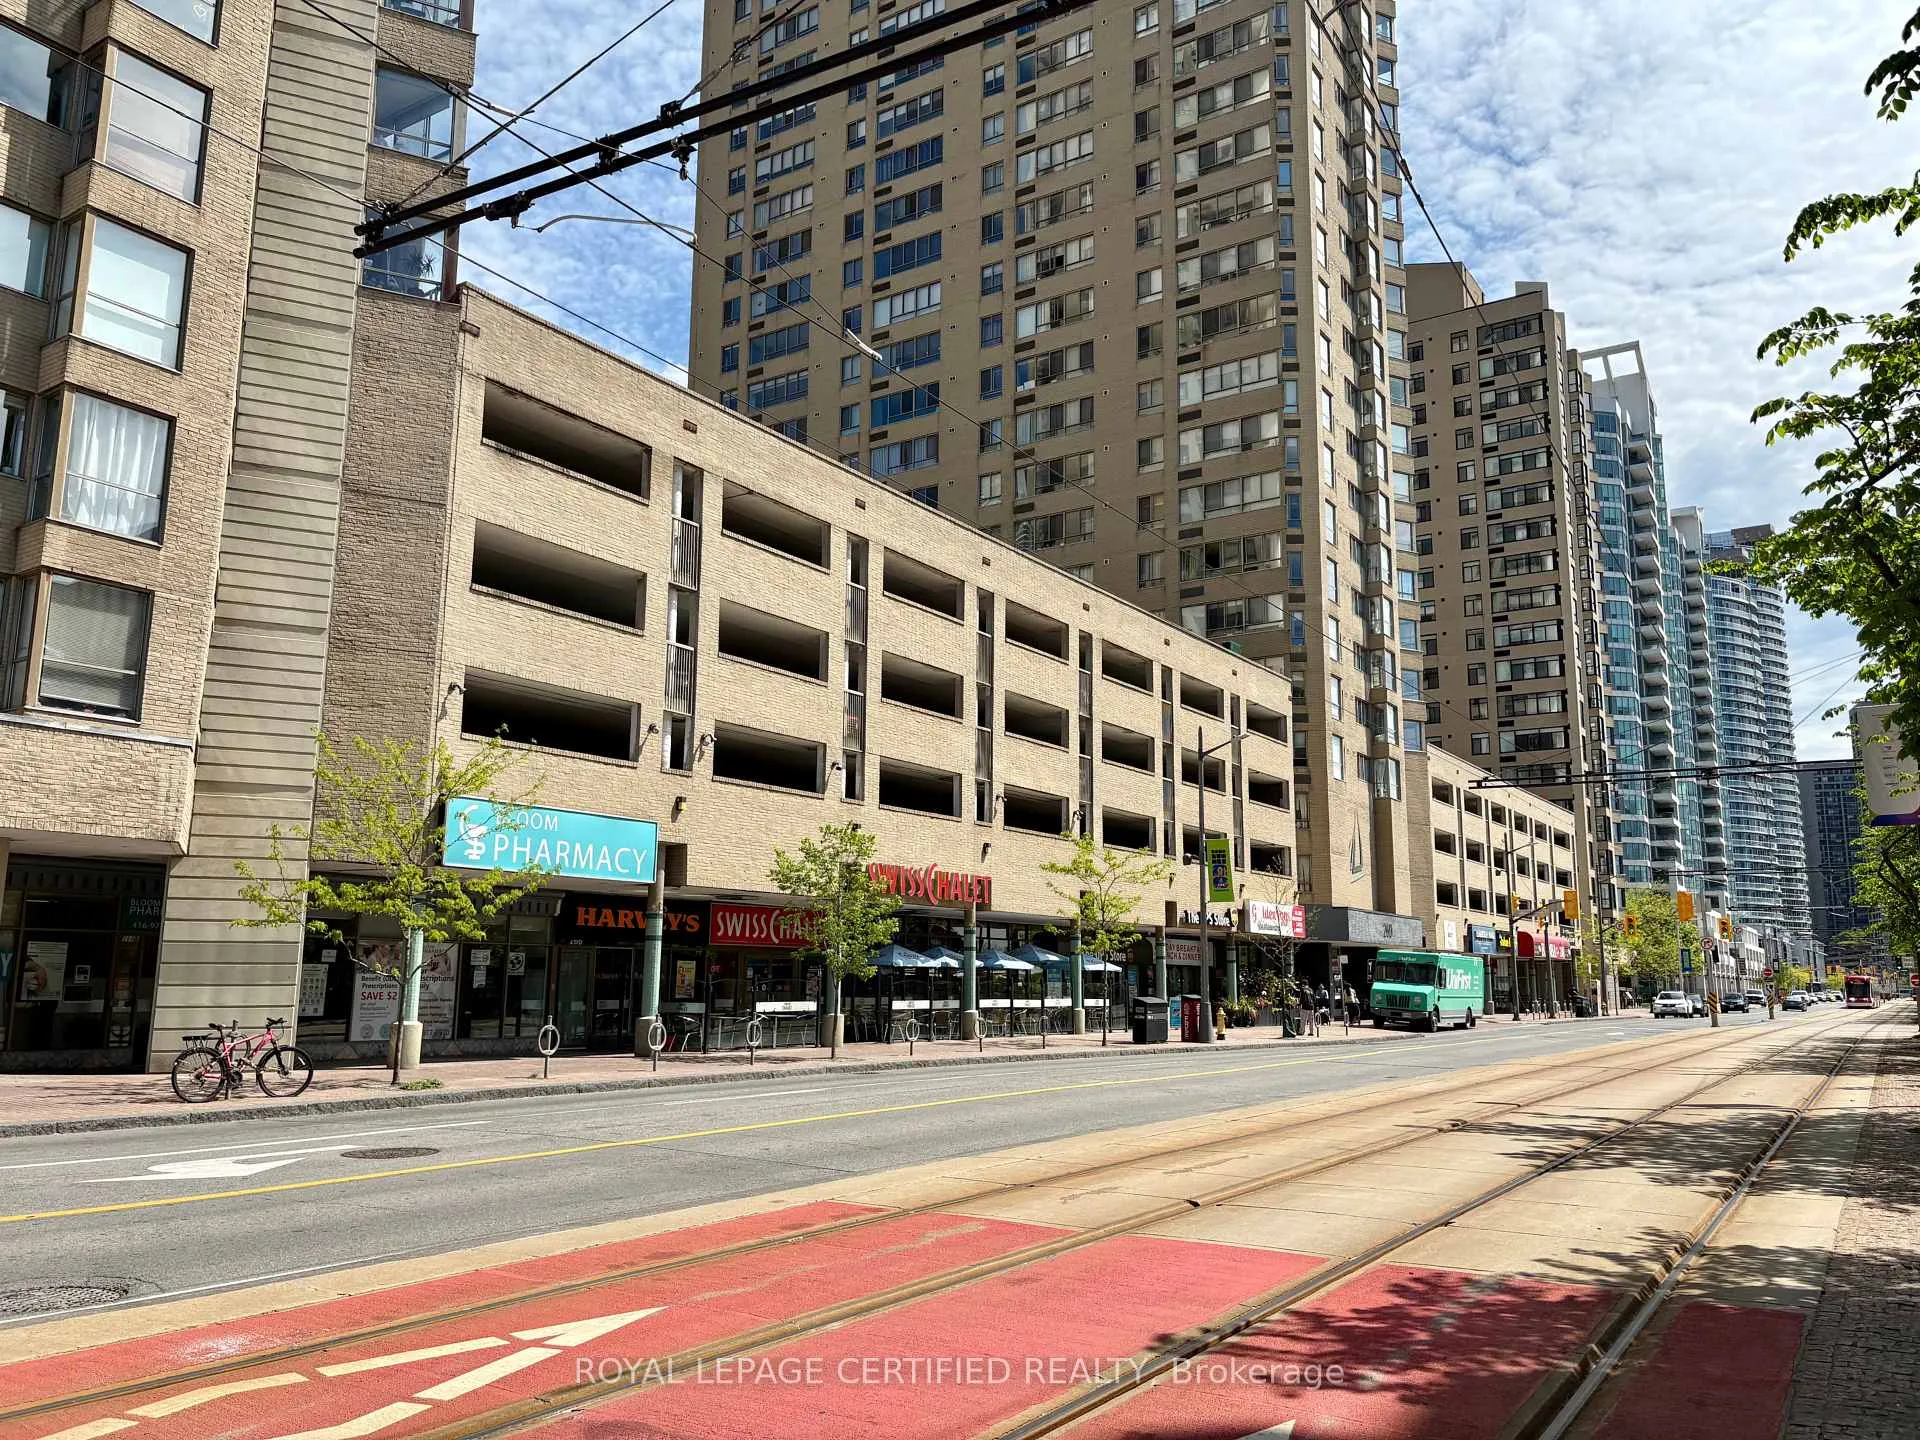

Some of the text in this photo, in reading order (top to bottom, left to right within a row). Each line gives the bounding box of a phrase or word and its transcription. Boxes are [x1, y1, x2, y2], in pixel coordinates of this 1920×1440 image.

[495, 810, 558, 832] OOM
[493, 833, 648, 875] PHARMACY
[926, 862, 992, 906] CHALET
[128, 905, 160, 916] PHAR
[575, 906, 701, 933] HARVY'S
[716, 911, 767, 939] SWISS
[1109, 949, 1127, 962] Store
[360, 991, 384, 1001] SAVE
